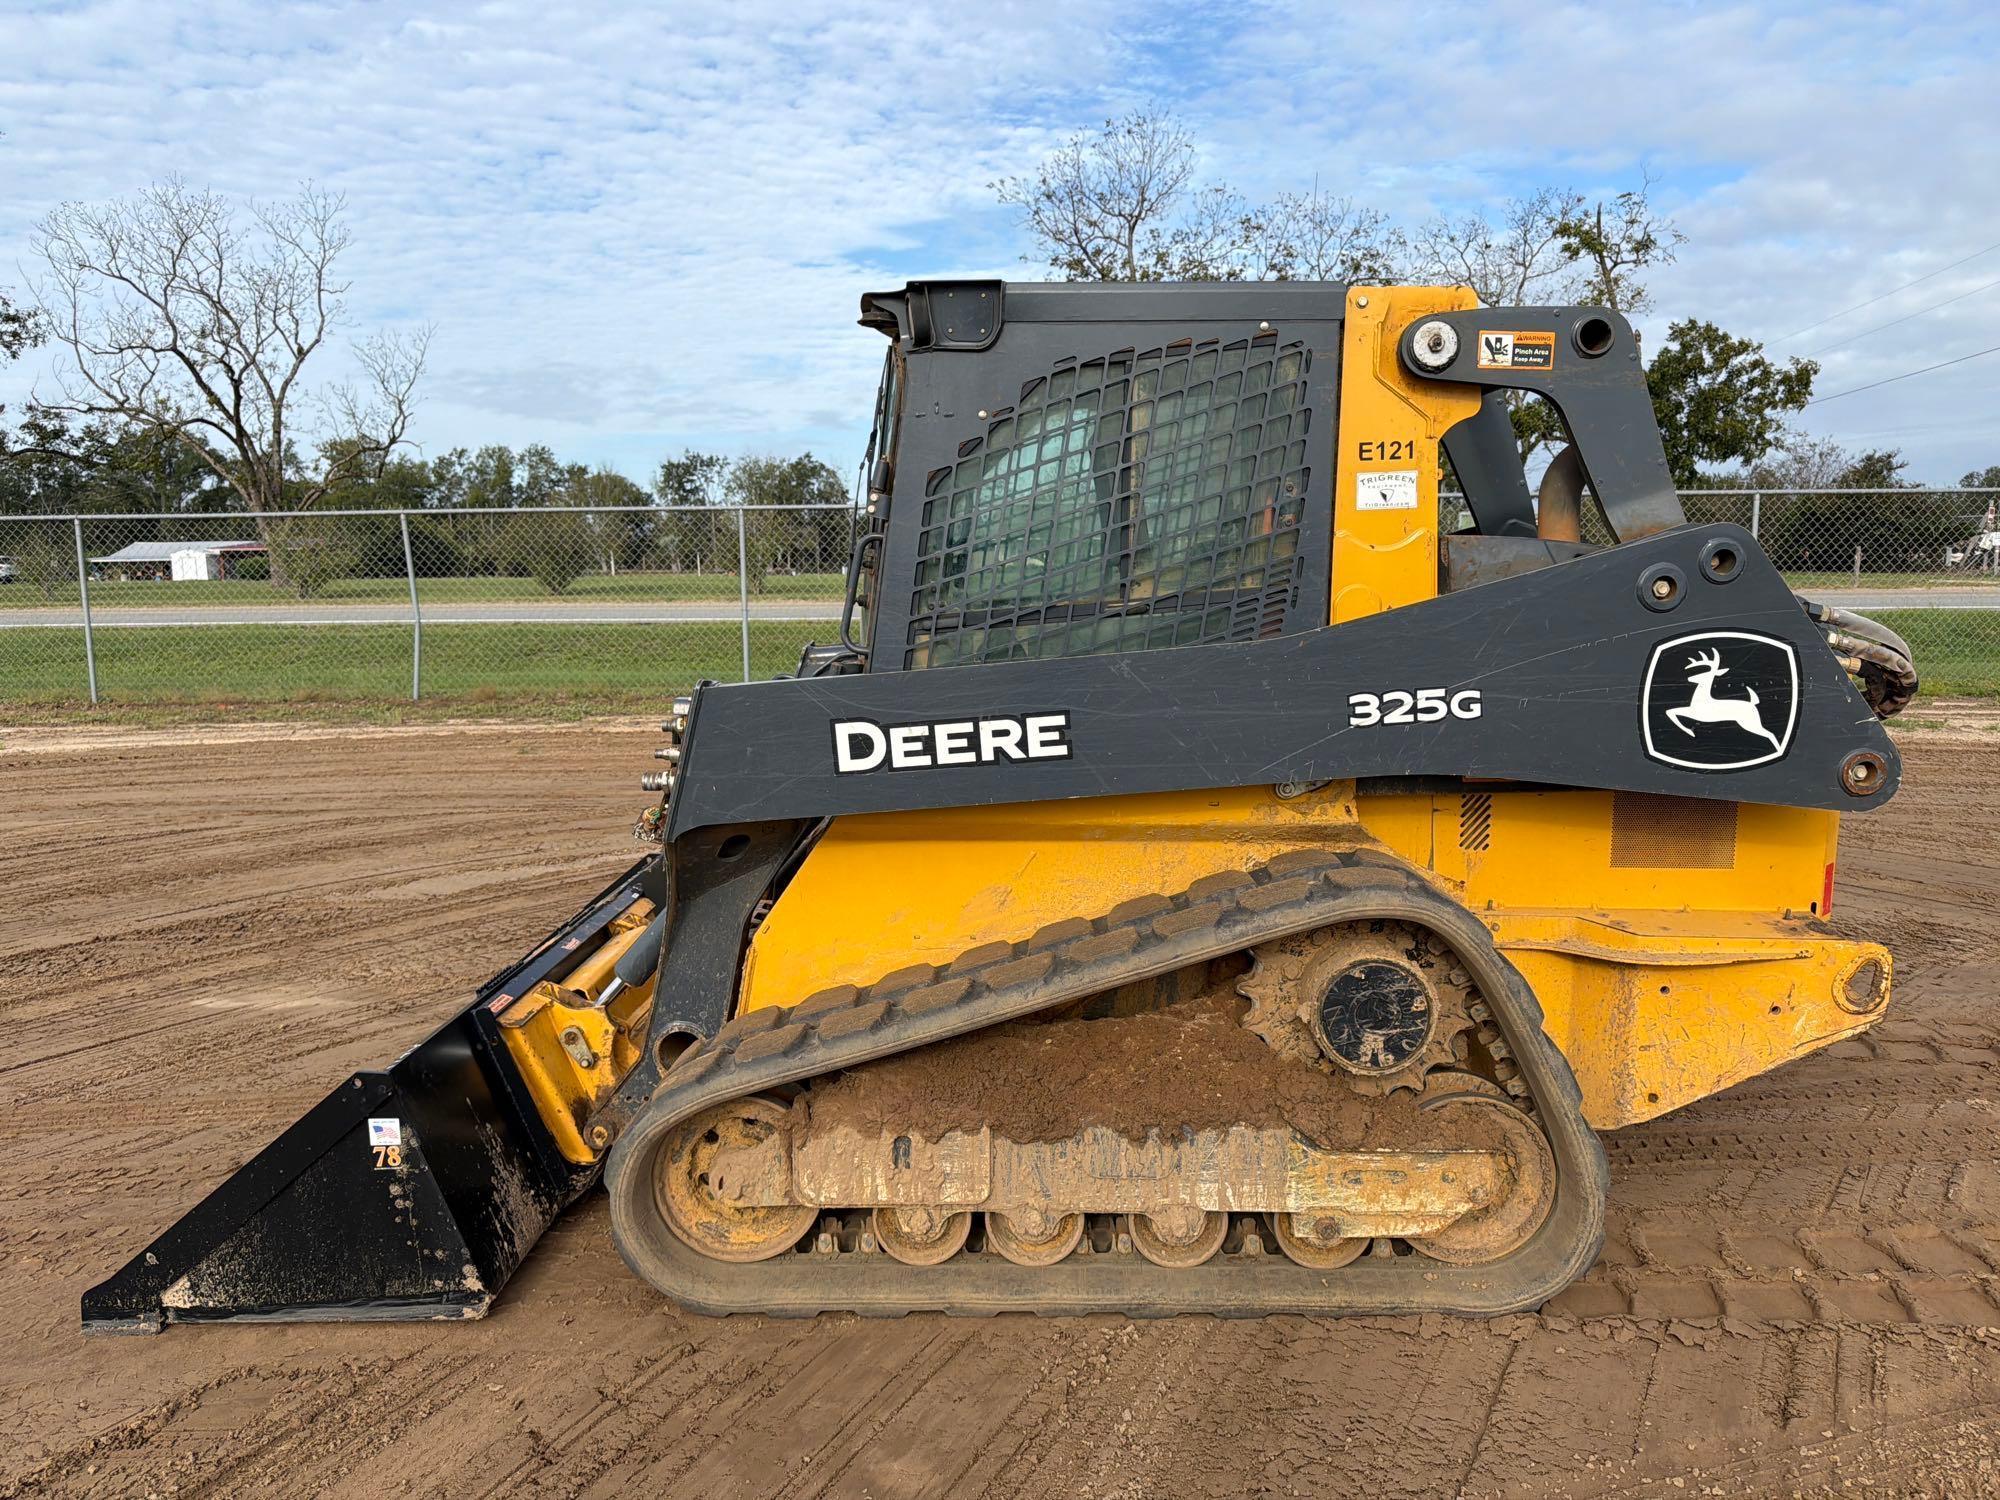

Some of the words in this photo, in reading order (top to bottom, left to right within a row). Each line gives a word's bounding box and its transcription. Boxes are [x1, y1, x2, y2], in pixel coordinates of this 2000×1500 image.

[1359, 440, 1414, 461] E121
[1348, 687, 1482, 727] 325G
[834, 714, 1069, 773] DEERE
[372, 1145, 402, 1167] 78
